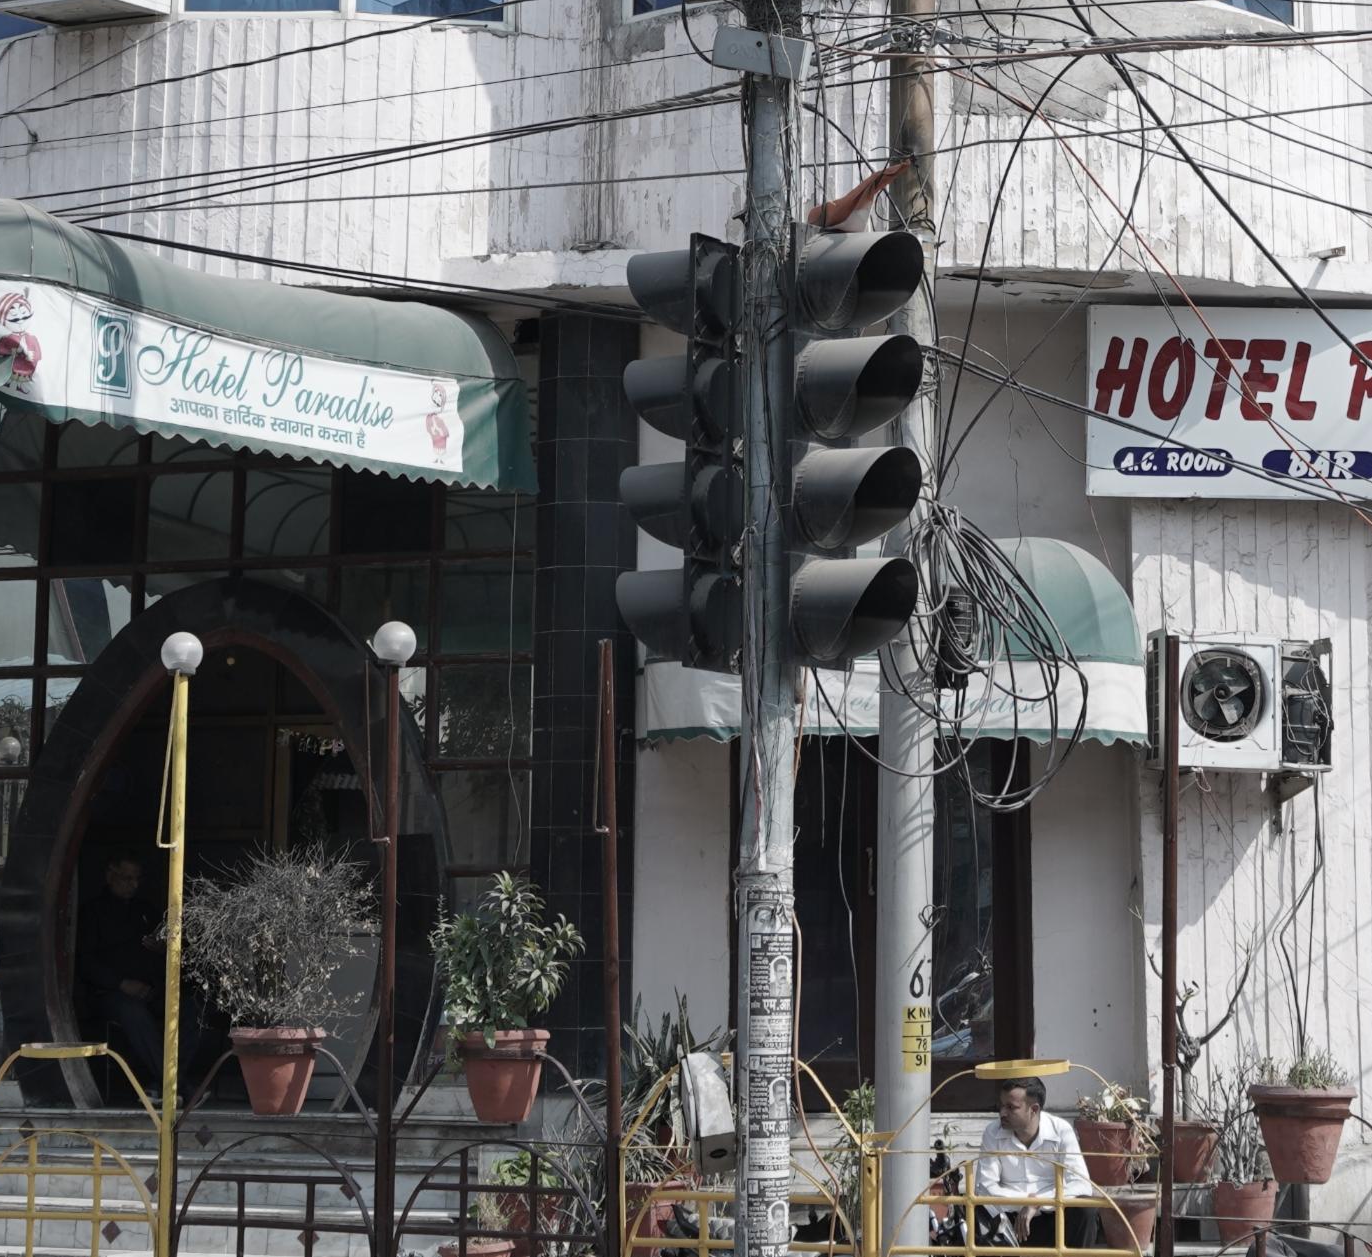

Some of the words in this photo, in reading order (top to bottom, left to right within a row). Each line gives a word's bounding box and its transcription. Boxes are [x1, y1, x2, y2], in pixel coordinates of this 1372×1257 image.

[137, 325, 257, 401] Hotel
[262, 348, 394, 429] Paradise
[1094, 335, 1317, 422] HOTEL
[169, 397, 218, 421] आपका
[222, 404, 266, 428] हार्दिक
[270, 415, 313, 438] स्वागत
[317, 424, 352, 445] करता
[356, 426, 366, 448] है
[1167, 451, 1226, 472] ROOM
[1288, 449, 1357, 479] BAR
